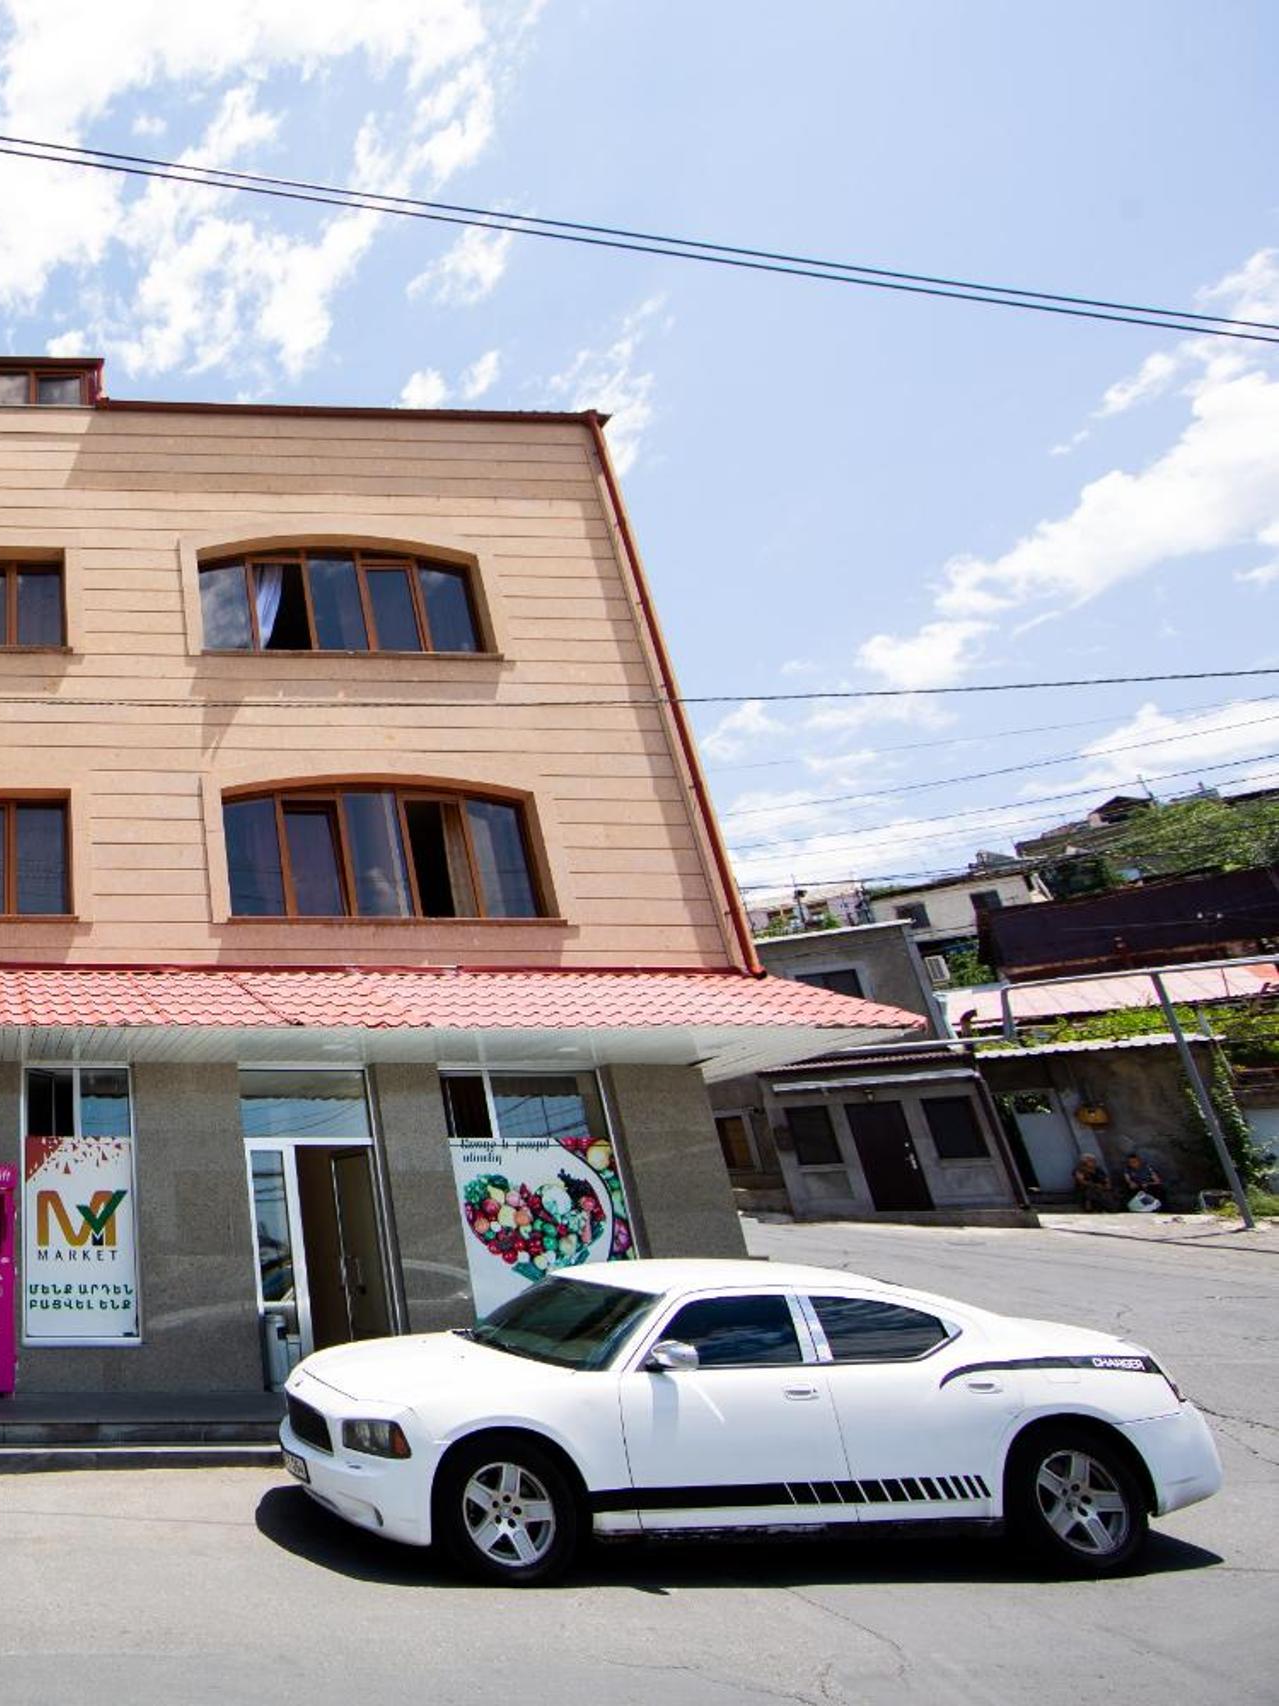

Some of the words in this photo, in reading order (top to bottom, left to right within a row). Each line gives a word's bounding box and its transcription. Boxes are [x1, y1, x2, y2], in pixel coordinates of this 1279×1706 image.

[37, 1250, 119, 1262] MARKET
[29, 1284, 72, 1295] ՄԵՆՔ
[79, 1284, 134, 1295] ԱՐԴԵՆ
[29, 1299, 94, 1310] ԲԱՑՎԵԼ
[99, 1299, 132, 1310] ԵՆՔ
[1091, 1357, 1146, 1370] CHARGER
